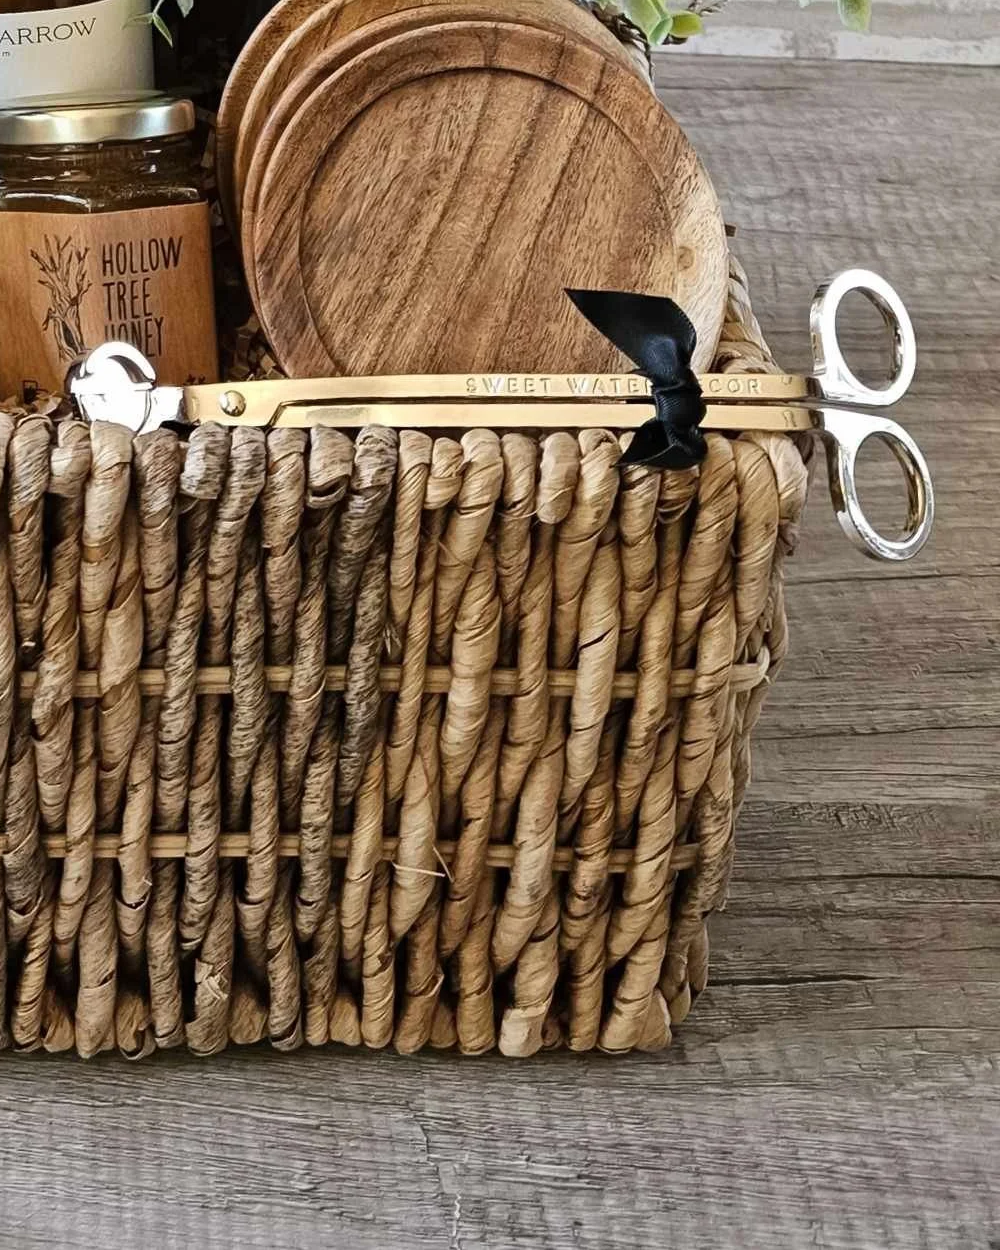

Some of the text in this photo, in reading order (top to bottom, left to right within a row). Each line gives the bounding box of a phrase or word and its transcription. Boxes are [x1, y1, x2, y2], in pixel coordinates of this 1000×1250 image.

[102, 236, 183, 277] HOLLOW
[102, 277, 153, 321] TREE
[465, 376, 551, 396] SWEET
[701, 377, 760, 395] COR
